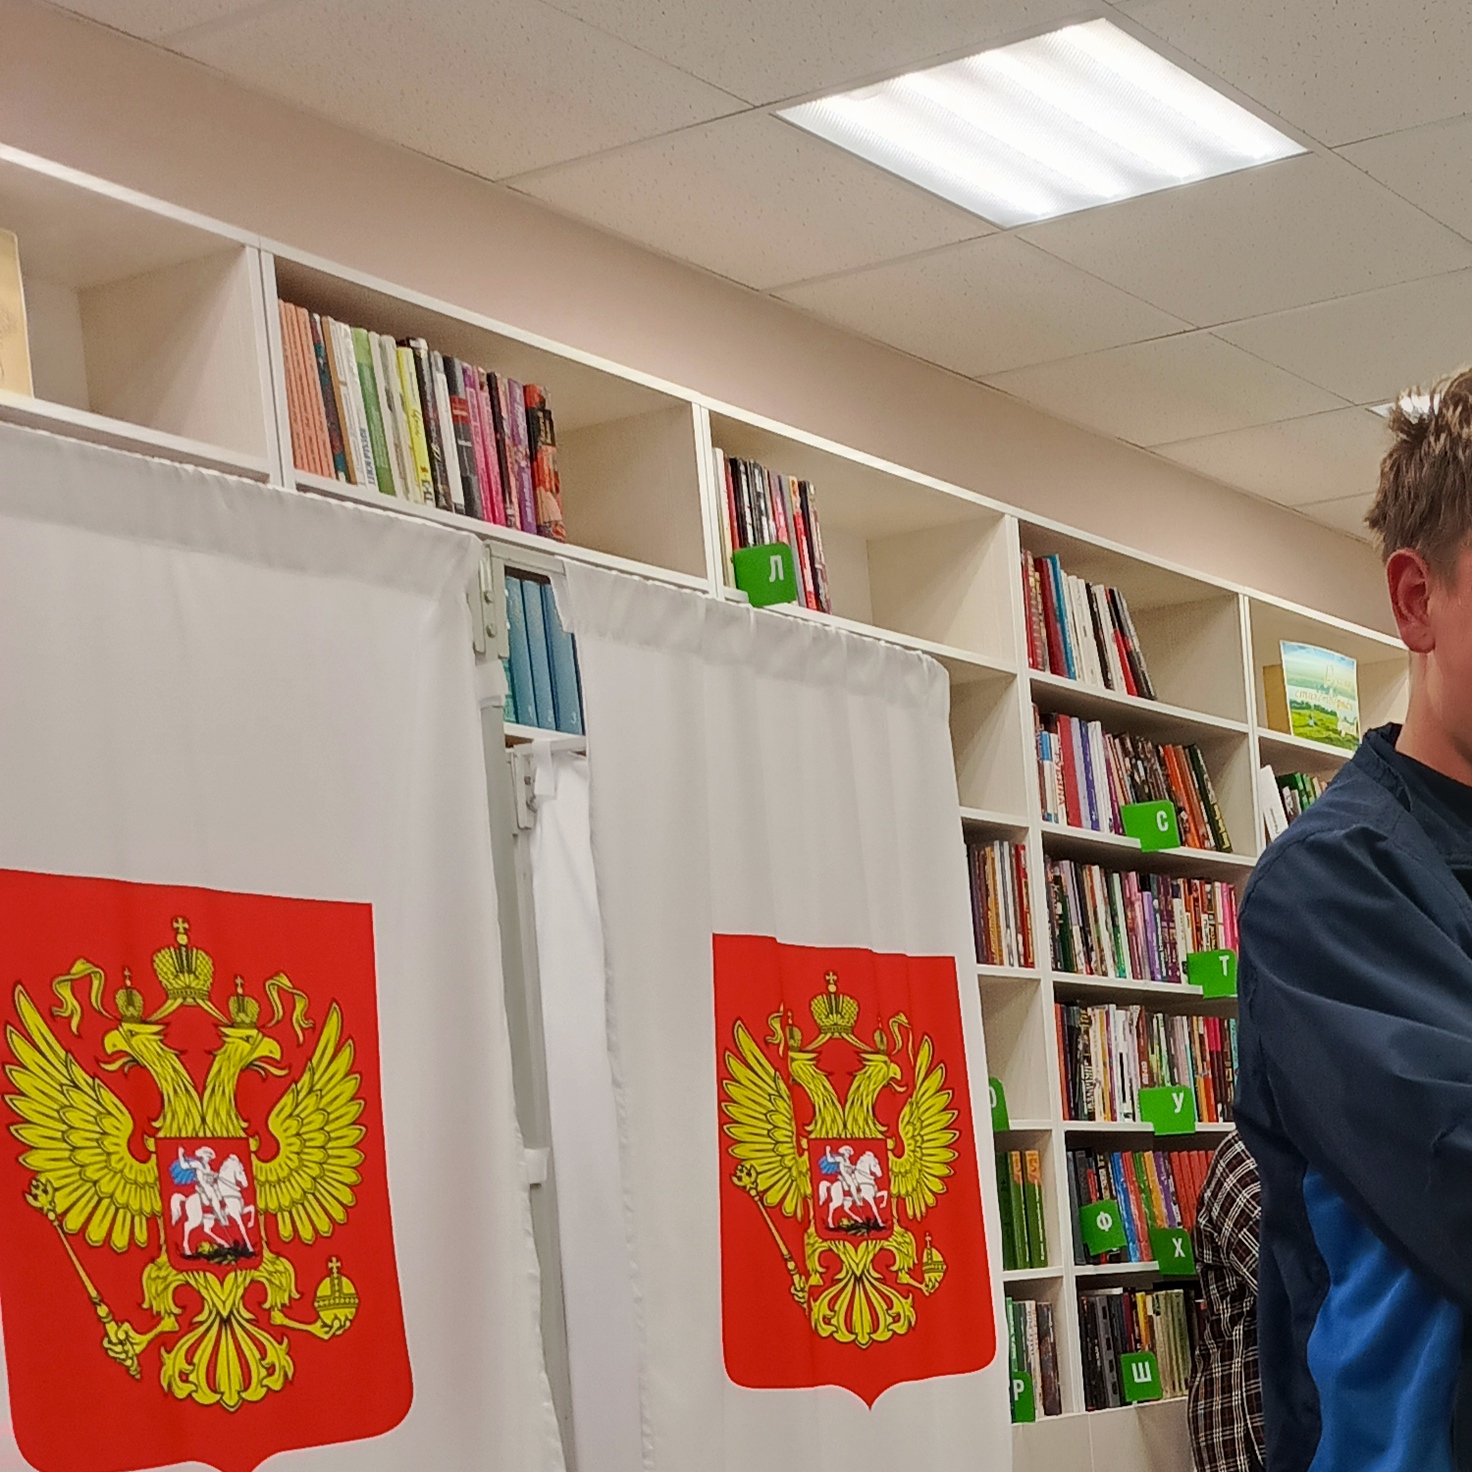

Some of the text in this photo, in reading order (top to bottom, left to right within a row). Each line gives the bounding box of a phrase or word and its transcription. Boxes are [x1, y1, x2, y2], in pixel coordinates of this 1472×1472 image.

[769, 555, 784, 582] Л
[1156, 810, 1169, 832] С
[1219, 955, 1230, 977] Т
[1172, 1092, 1185, 1113] У
[1096, 1211, 1113, 1232] Ф
[1172, 1237, 1186, 1258] Х
[1131, 1361, 1152, 1384] Ш
[1013, 1379, 1025, 1401] Р
